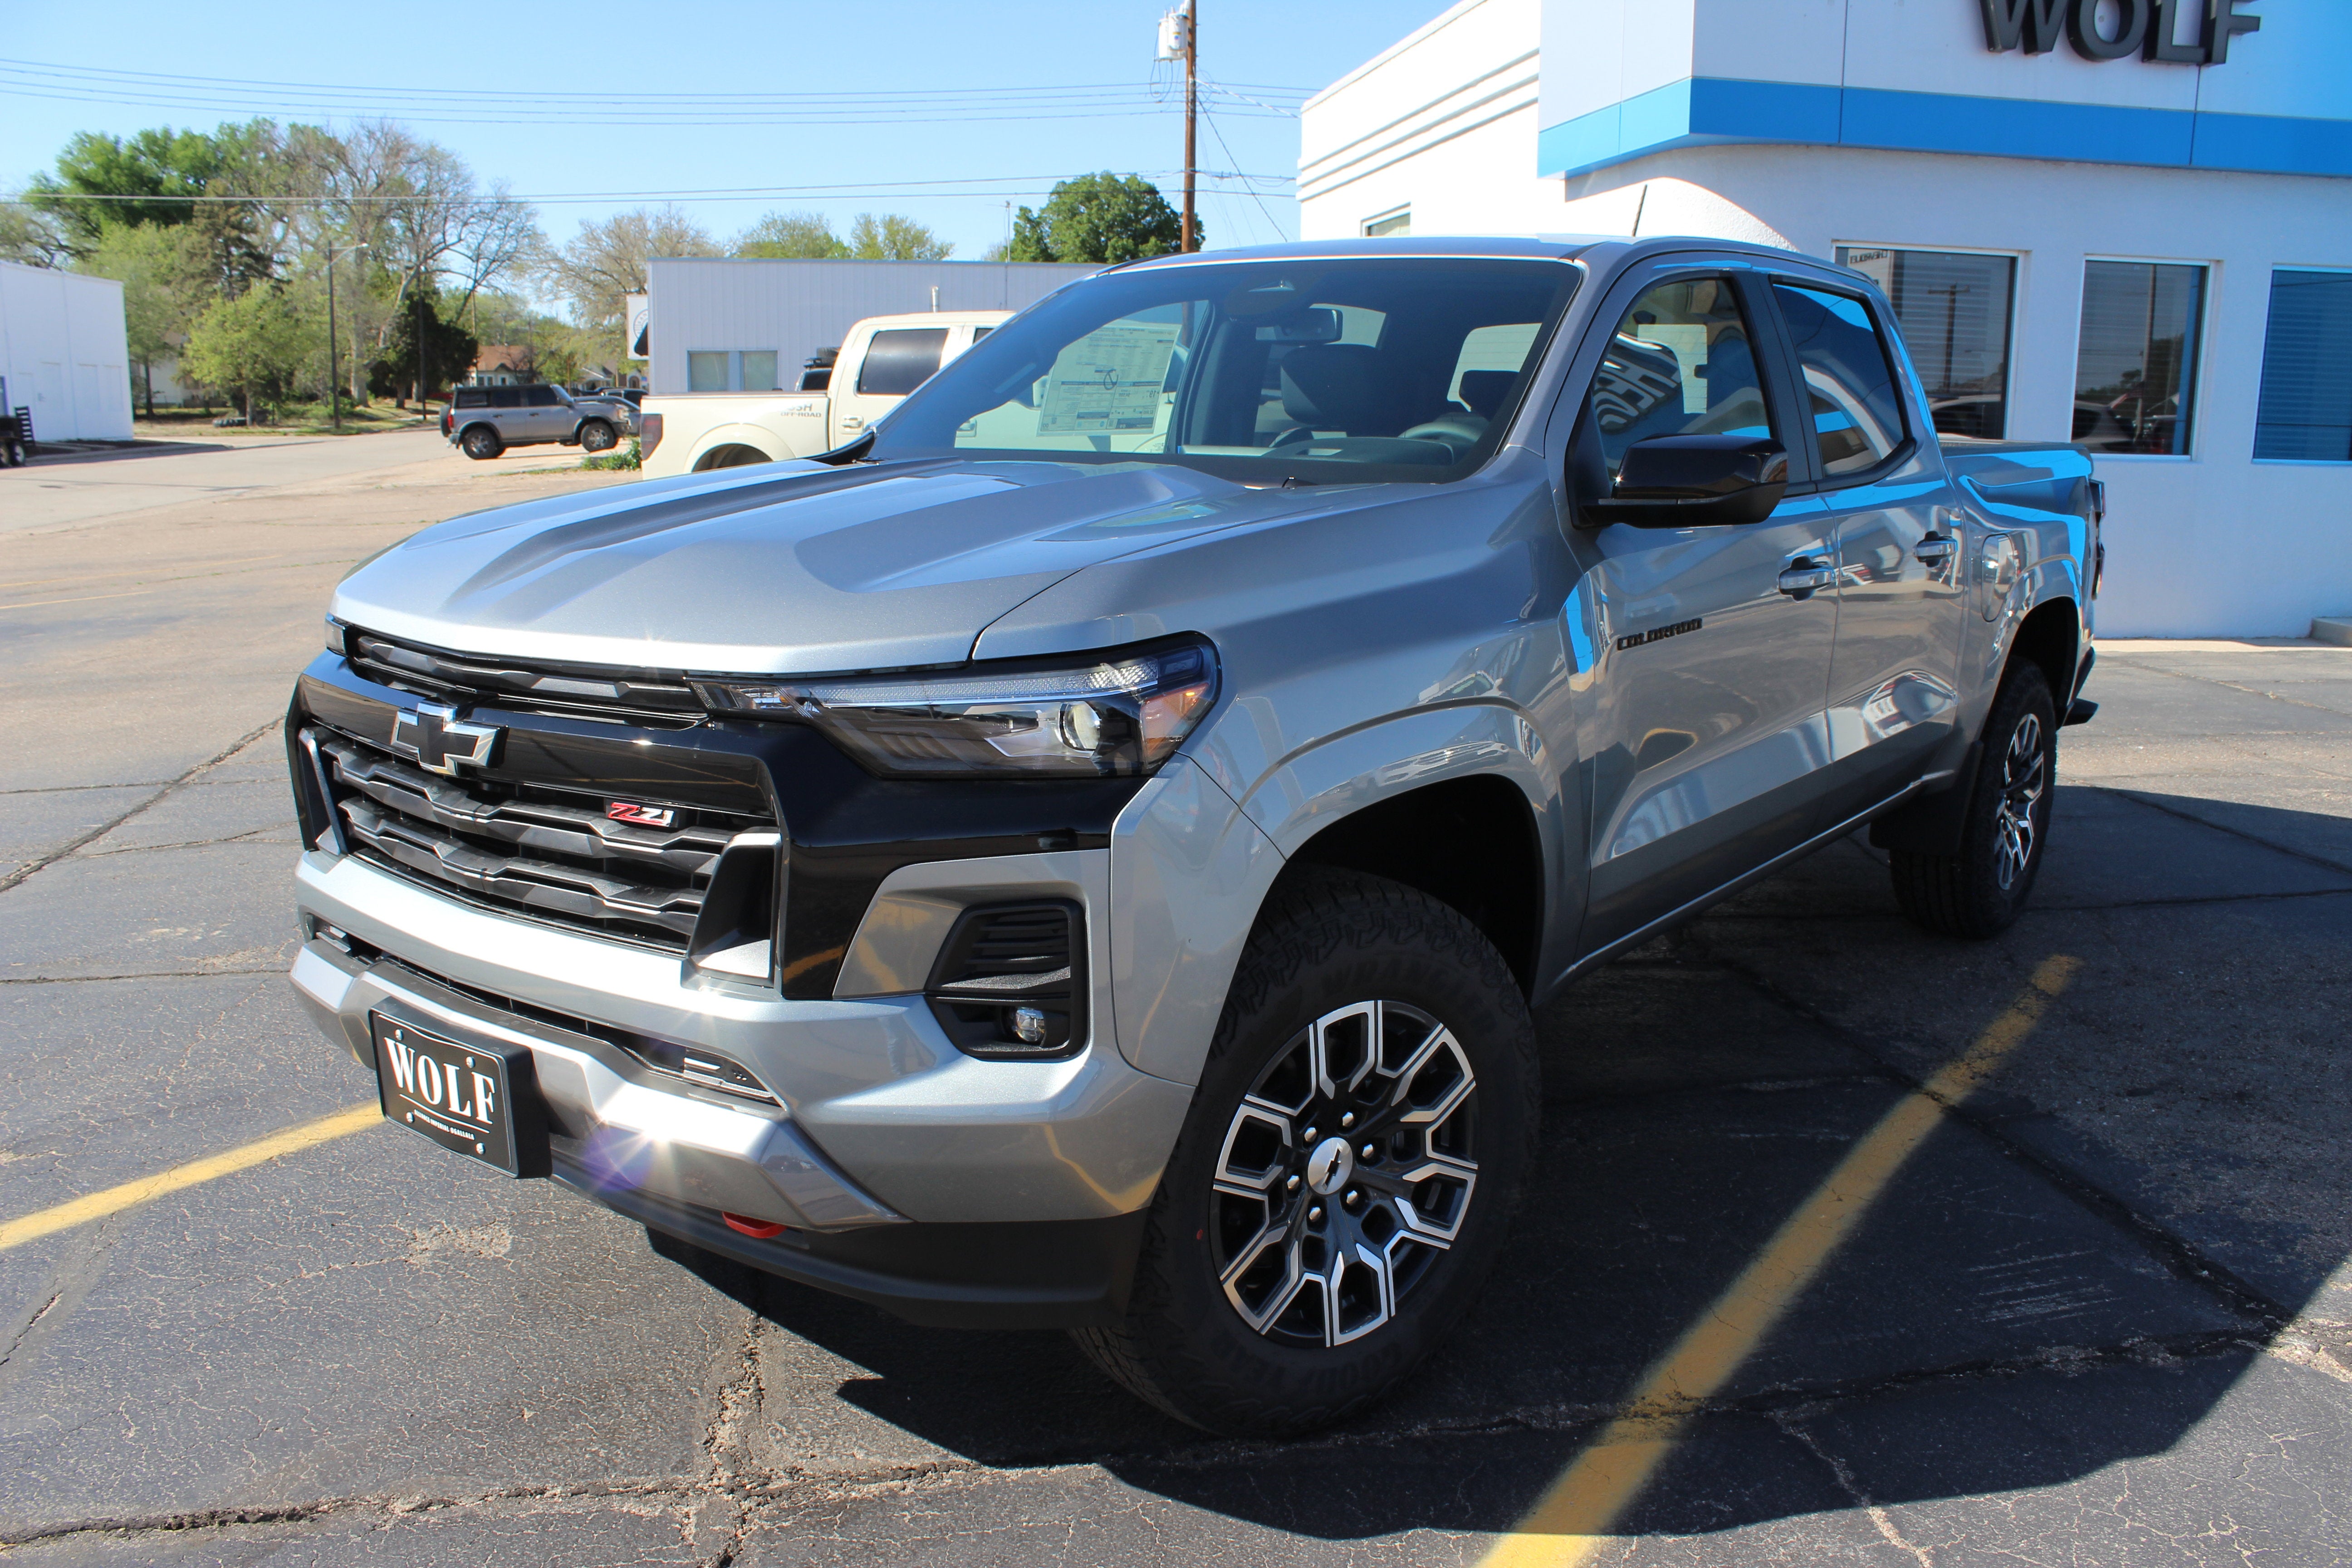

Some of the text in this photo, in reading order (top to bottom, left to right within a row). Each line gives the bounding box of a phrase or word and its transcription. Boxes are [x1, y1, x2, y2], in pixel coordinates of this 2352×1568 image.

[1980, 0, 2261, 66] WOLF
[1617, 617, 1702, 651] COLORADO
[608, 802, 675, 828] Z71
[384, 1037, 496, 1125] WOLF
[430, 1118, 450, 1132] IMPERIAL
[450, 1127, 475, 1141] OGALLALA
